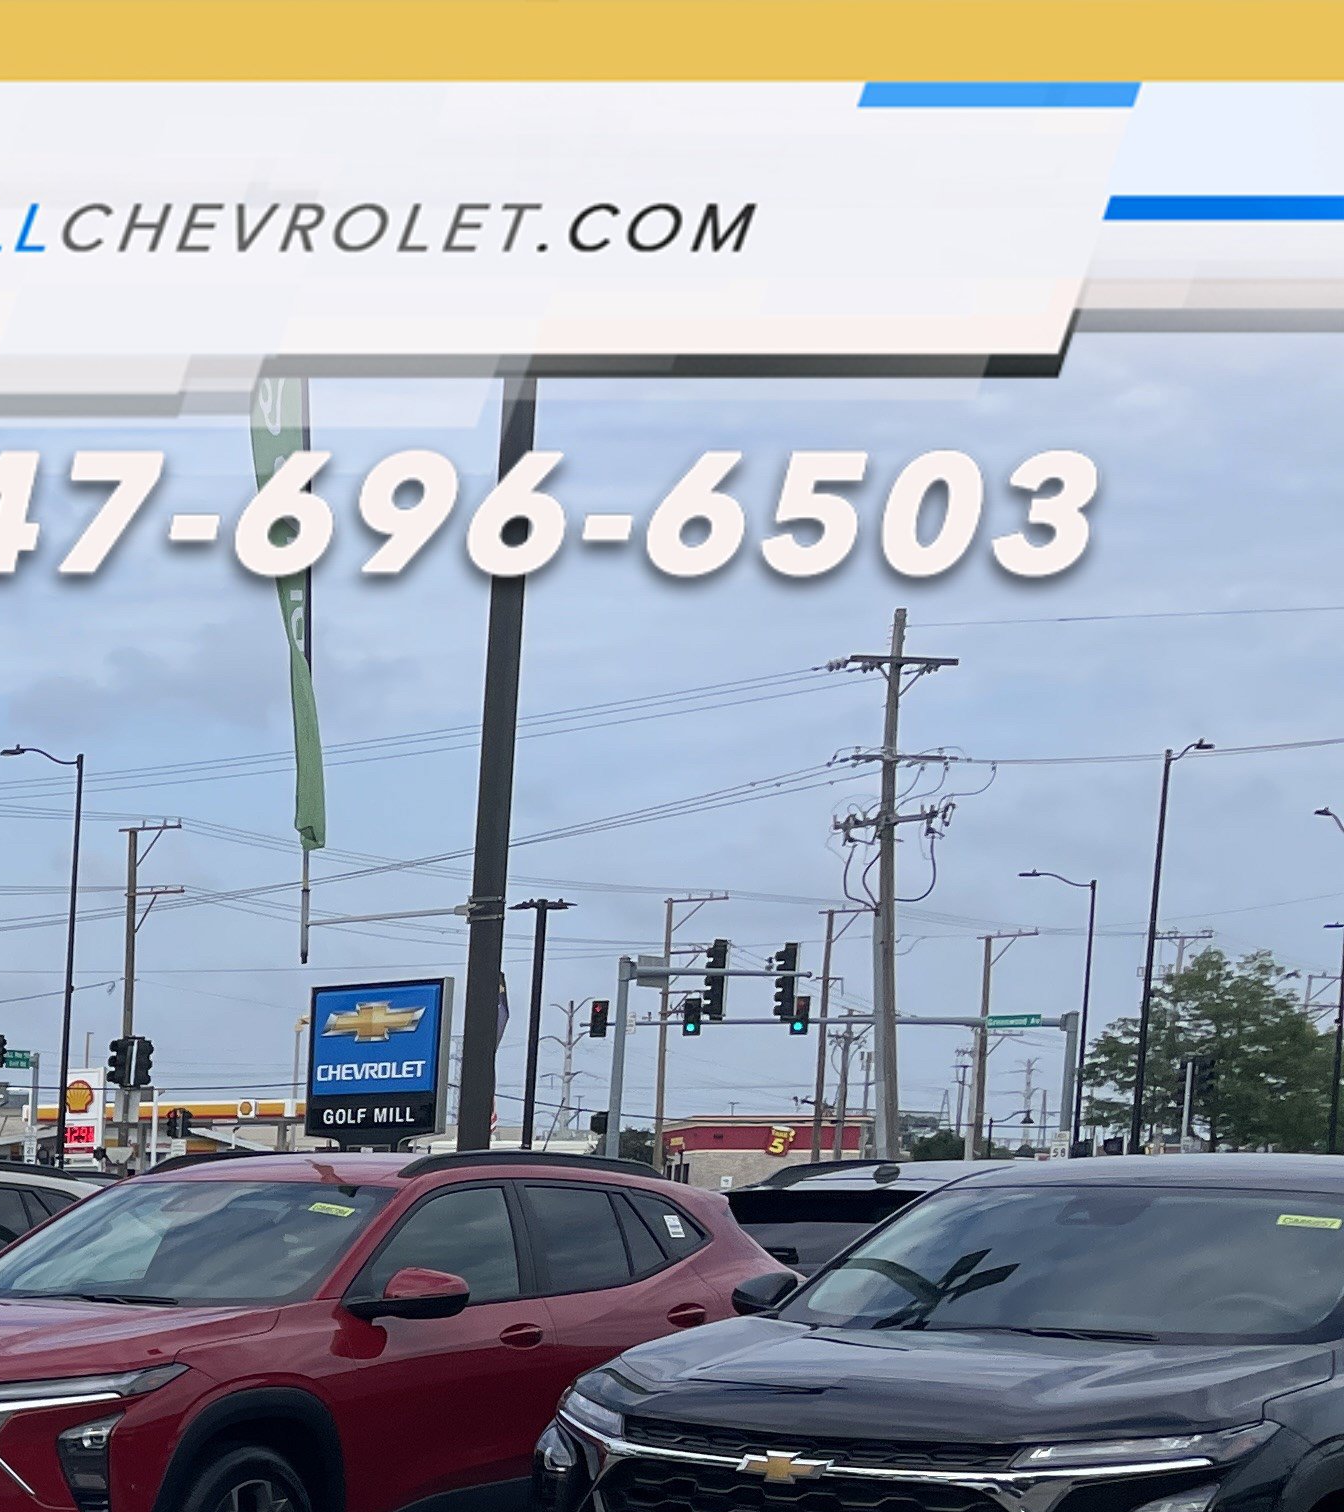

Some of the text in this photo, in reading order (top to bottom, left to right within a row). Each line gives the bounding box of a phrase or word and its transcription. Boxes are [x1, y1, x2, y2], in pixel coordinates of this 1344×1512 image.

[316, 1060, 426, 1082] CHEVROLET
[323, 1106, 415, 1125] GOLF MILL
[769, 1138, 784, 1153] 5
[1052, 1148, 1066, 1157] 58
